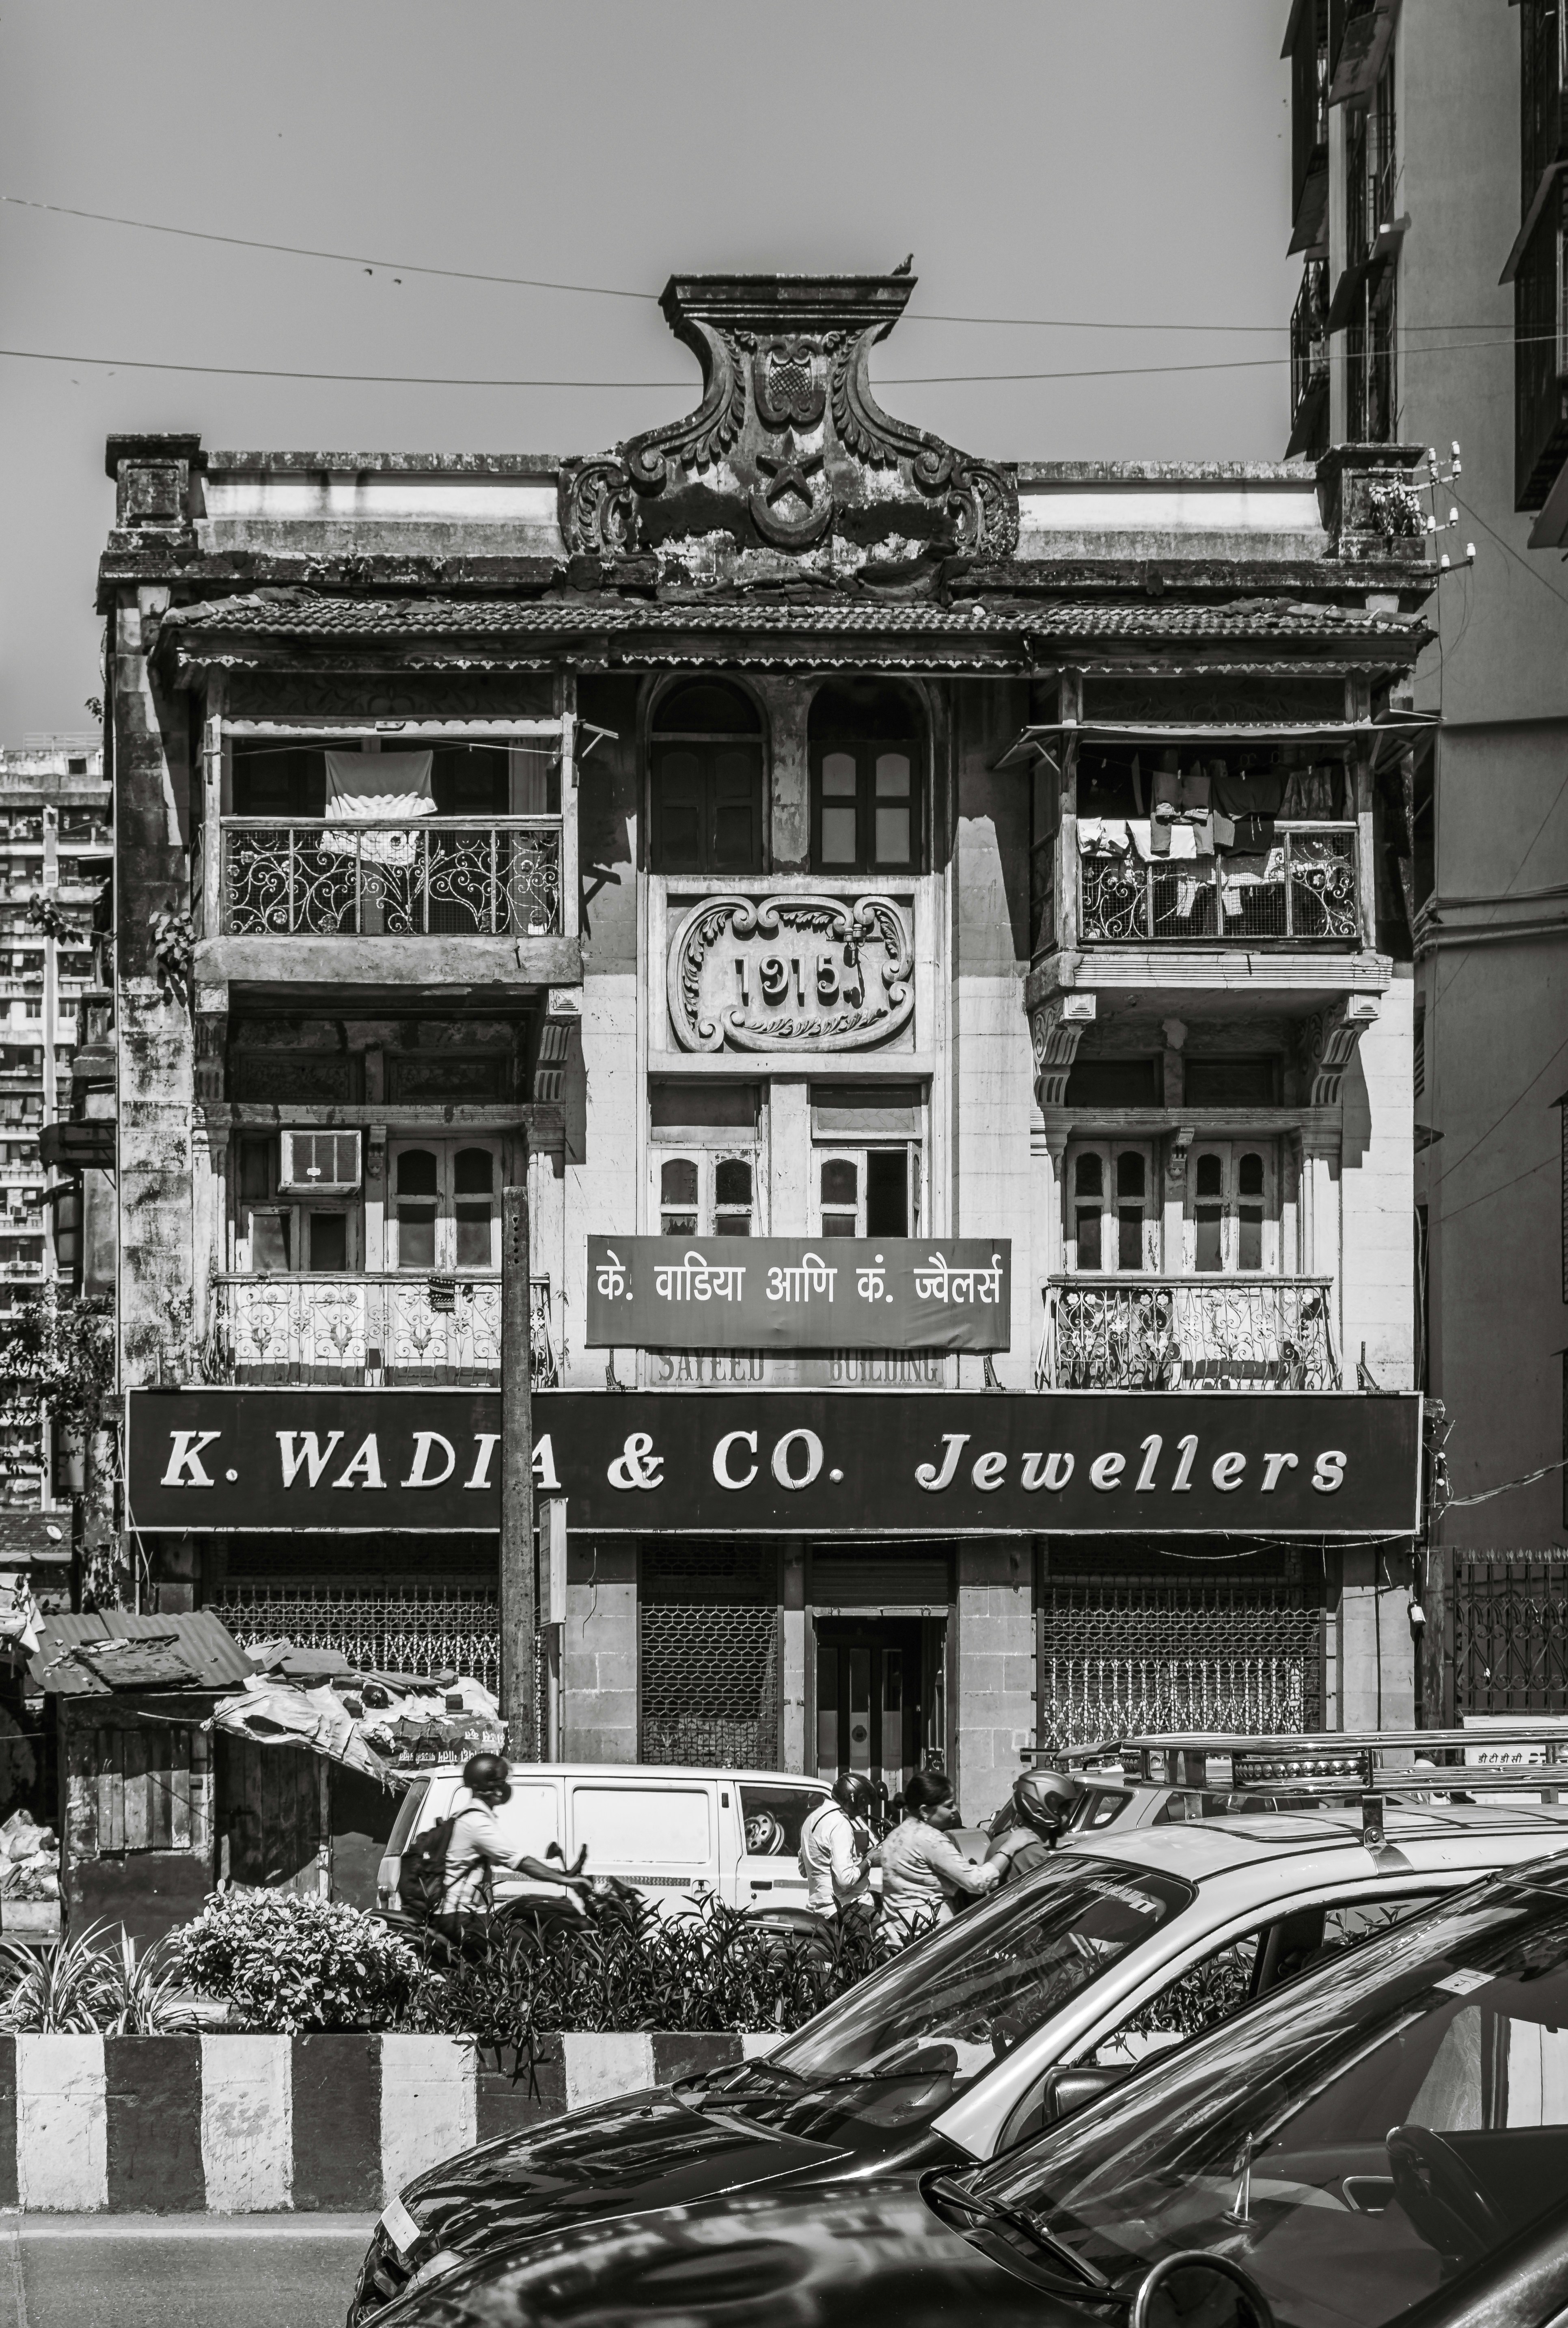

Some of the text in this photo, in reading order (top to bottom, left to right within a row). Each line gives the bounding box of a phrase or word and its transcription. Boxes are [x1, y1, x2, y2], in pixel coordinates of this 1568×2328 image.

[734, 954, 840, 993] 1915
[596, 1249, 1003, 1303] के. वाडिया आणि कं. ज्वैलर्स
[658, 1348, 938, 1382] SAYEED BUILDING
[160, 1429, 1347, 1491] K. WADIA & CO. Jewellers
